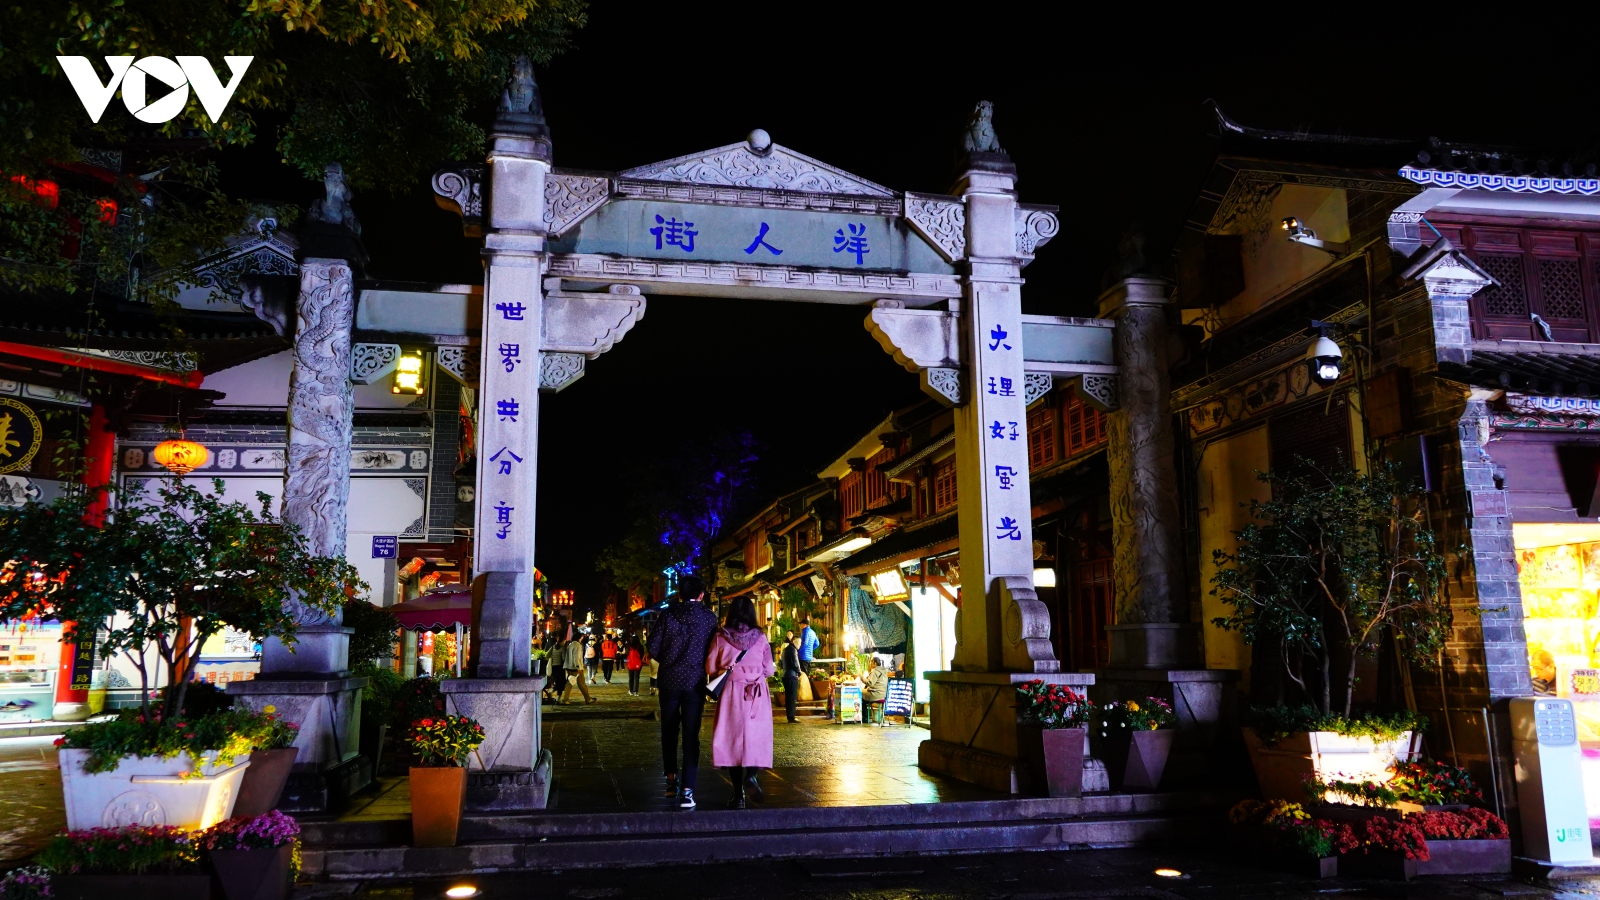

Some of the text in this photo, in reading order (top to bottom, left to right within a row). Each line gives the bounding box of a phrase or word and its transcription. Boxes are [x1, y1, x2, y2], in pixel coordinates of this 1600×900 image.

[489, 302, 526, 540] 世界共分享
